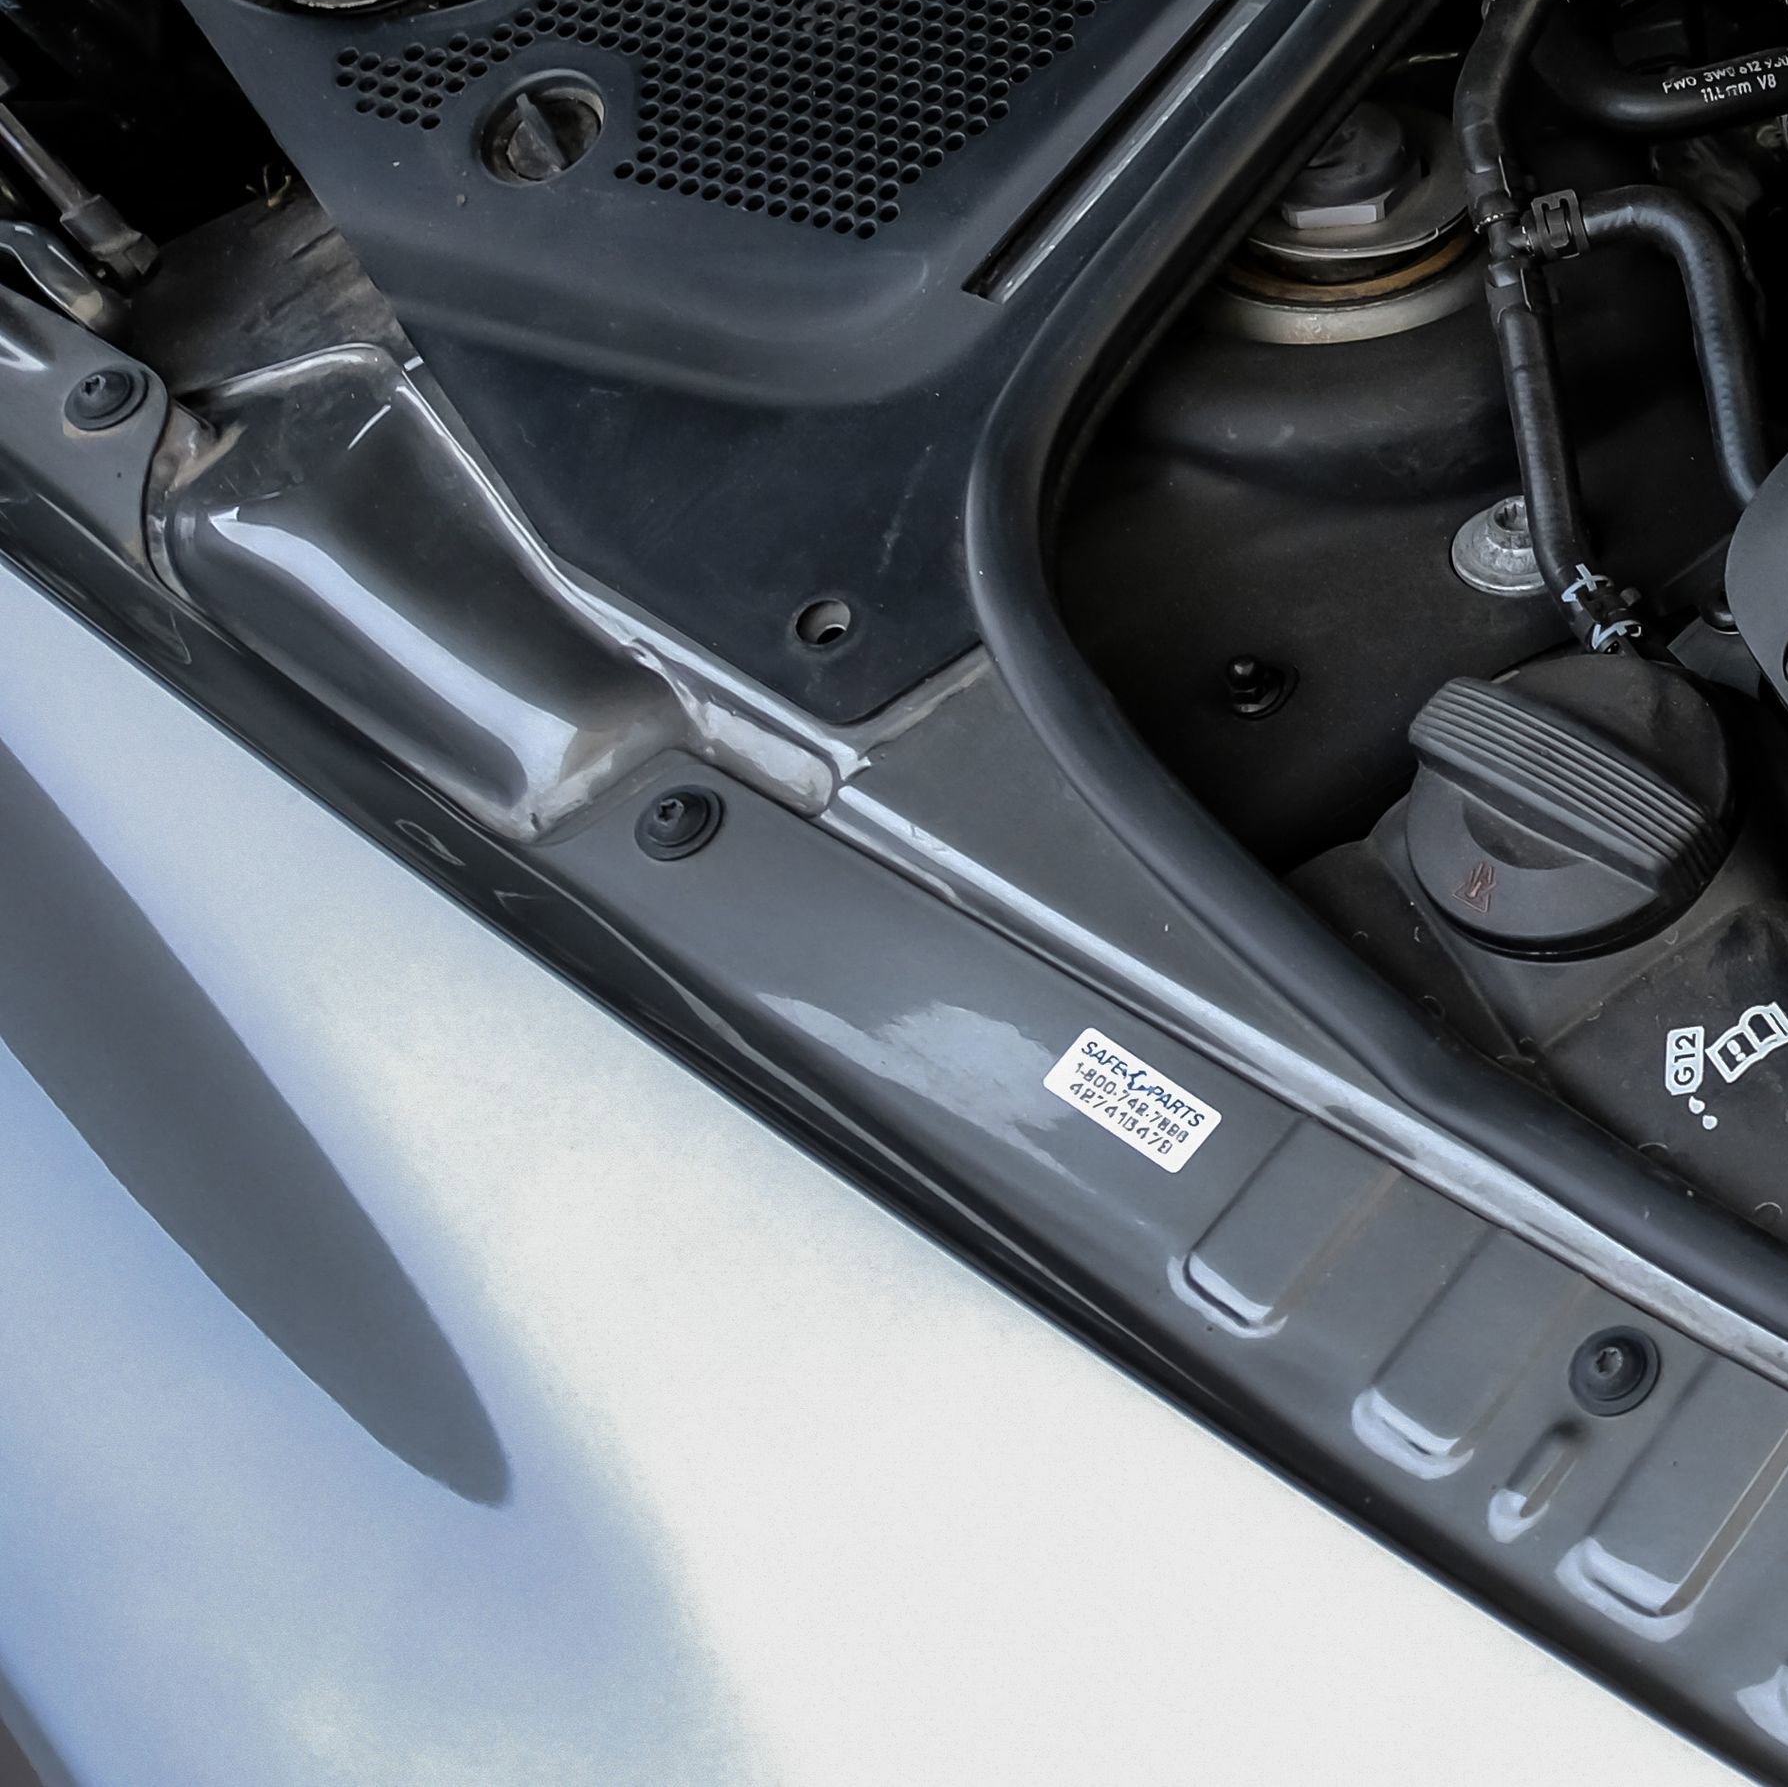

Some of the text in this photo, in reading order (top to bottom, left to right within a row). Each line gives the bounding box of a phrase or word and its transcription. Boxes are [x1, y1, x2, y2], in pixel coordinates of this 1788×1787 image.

[1081, 1041, 1205, 1128] SAFE PARTS
[1674, 1033, 1696, 1086] G12
